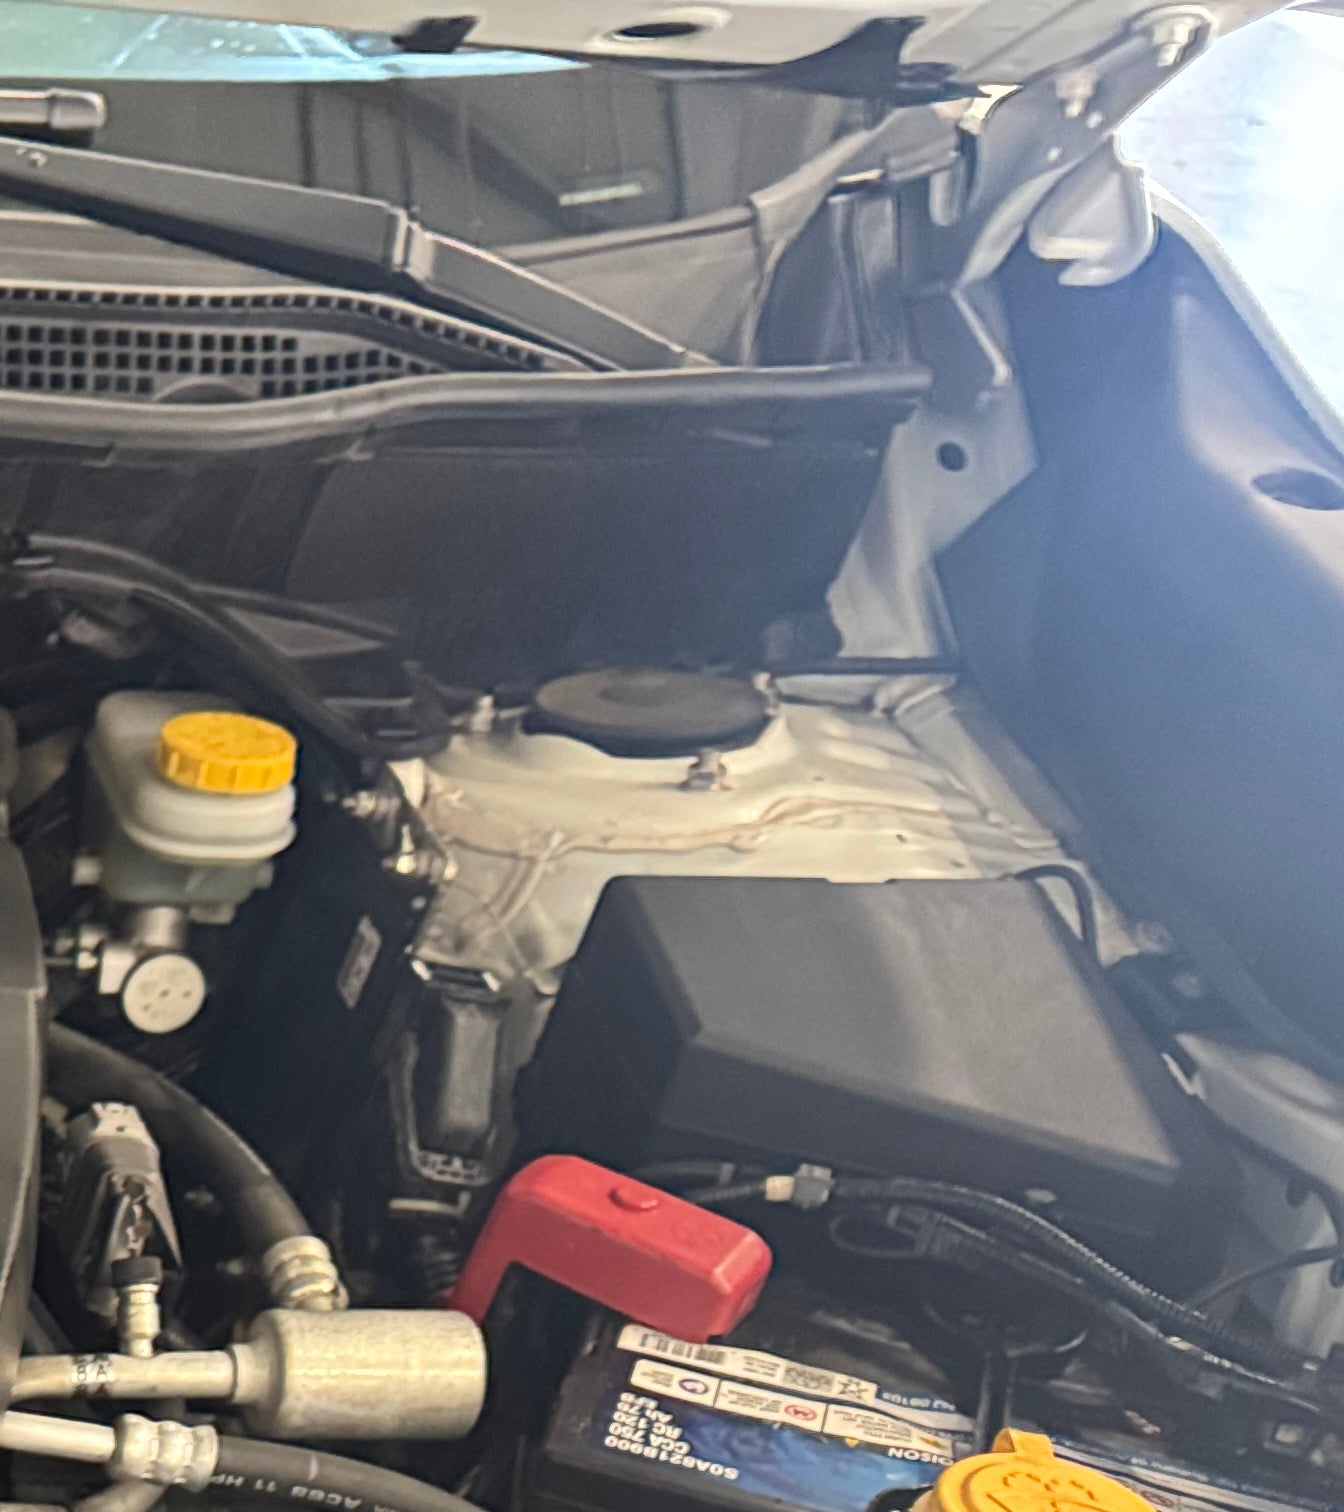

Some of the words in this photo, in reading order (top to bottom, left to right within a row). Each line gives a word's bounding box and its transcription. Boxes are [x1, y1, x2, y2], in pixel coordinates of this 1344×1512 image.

[613, 1411, 648, 1429] 120
[608, 1421, 647, 1443] 750
[652, 1421, 683, 1440] RC
[649, 1433, 691, 1455] CCA
[888, 1447, 954, 1467] OISON
